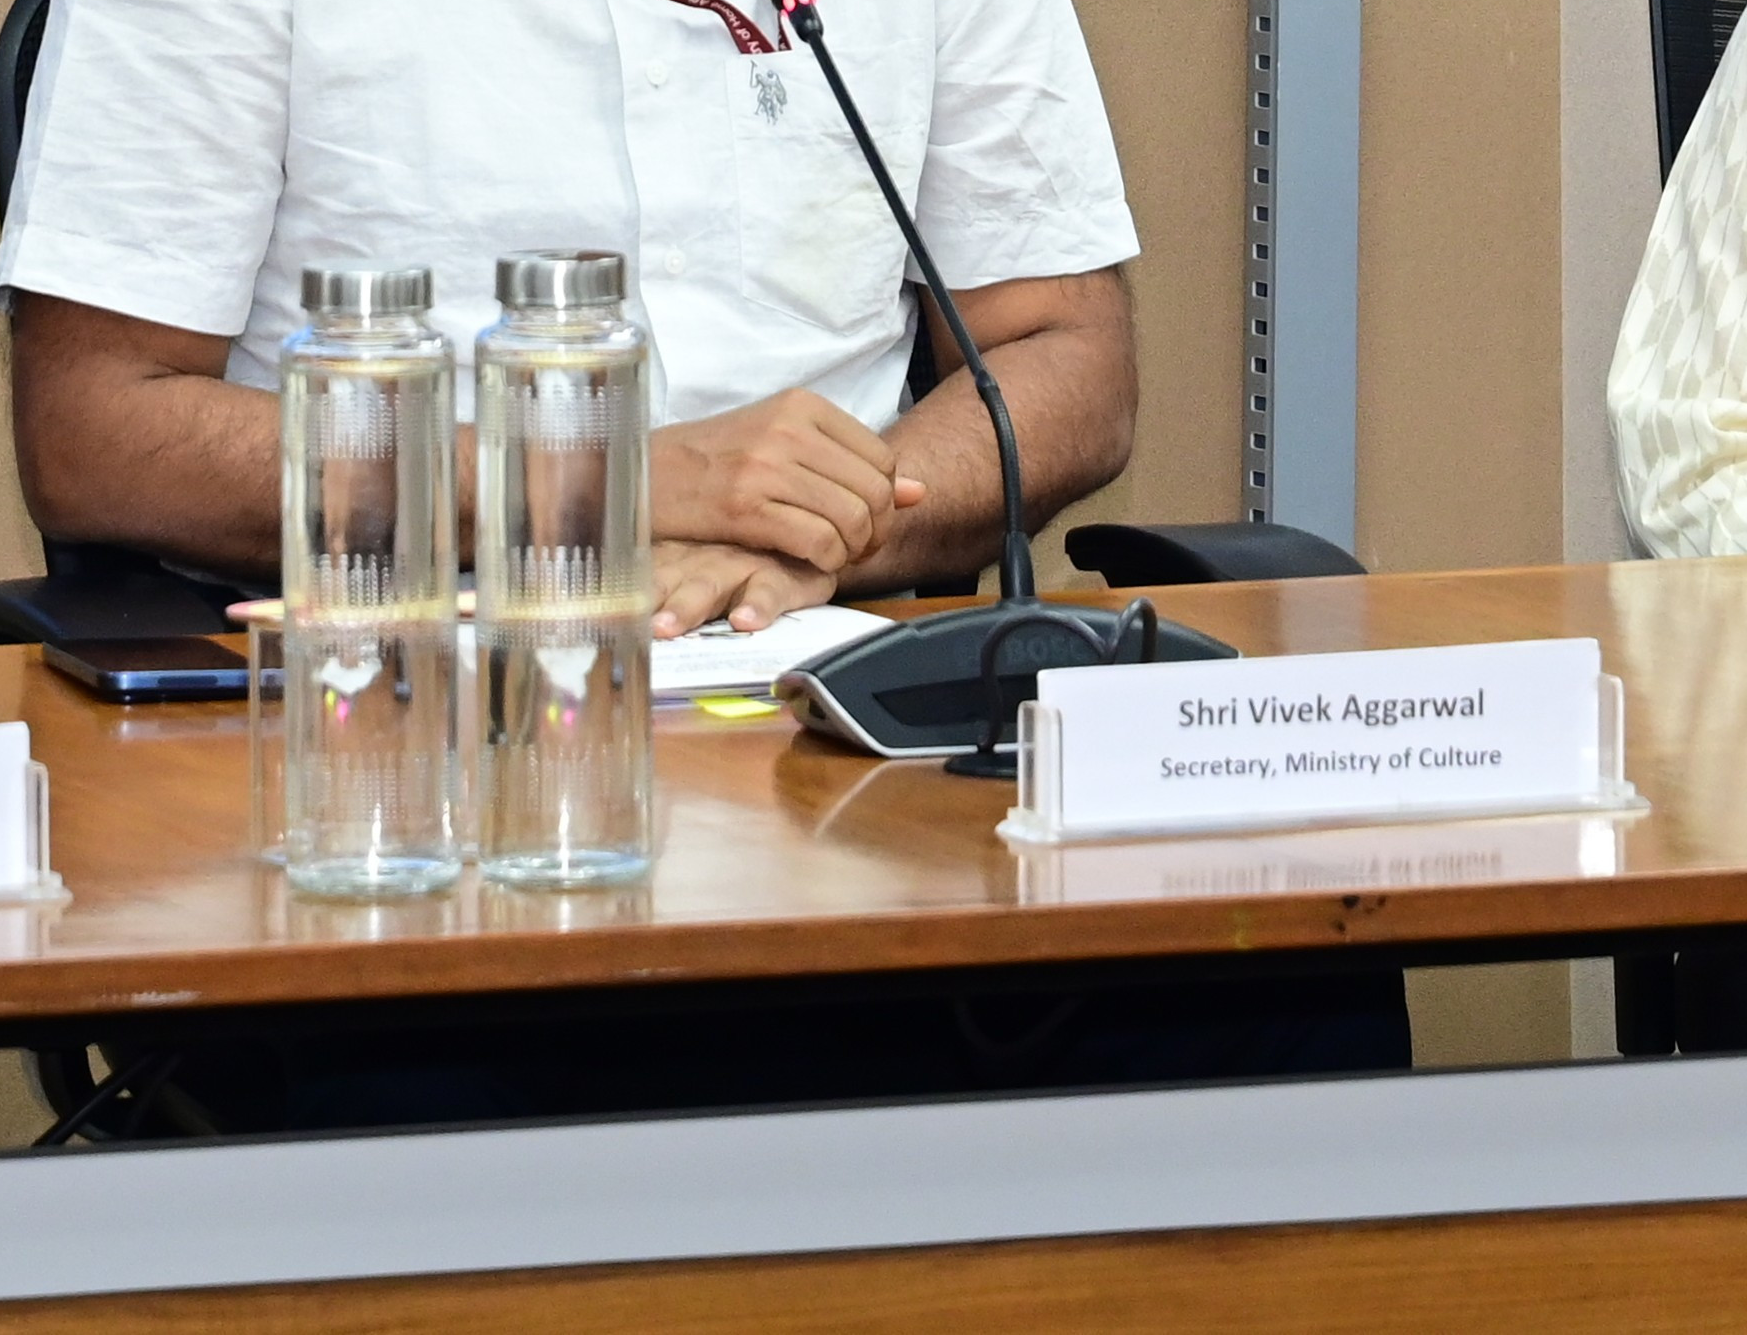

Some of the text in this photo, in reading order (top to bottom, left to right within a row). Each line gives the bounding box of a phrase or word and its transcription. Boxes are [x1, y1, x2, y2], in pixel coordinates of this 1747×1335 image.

[708, 1, 742, 25] Home
[738, 22, 752, 41] of
[1178, 687, 1485, 729] Shri Vivek Aggarwal
[1160, 745, 1503, 780] Secretary, Ministry of Culture
